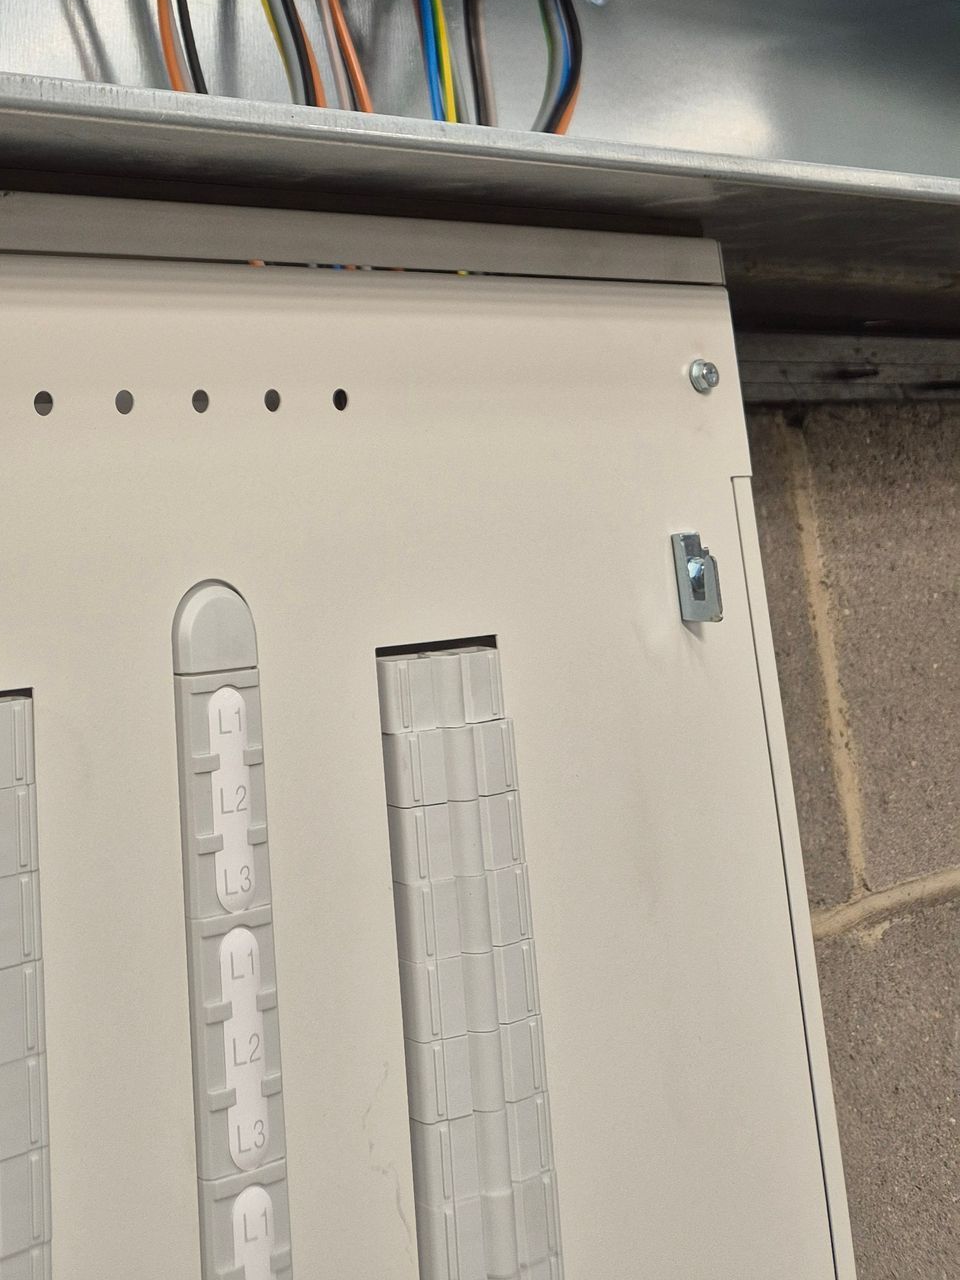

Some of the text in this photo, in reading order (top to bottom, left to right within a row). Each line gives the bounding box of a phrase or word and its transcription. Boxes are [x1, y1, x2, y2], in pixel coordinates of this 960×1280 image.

[218, 708, 242, 734] L1
[219, 785, 248, 815] L2
[223, 865, 252, 896] L3
[230, 949, 255, 980] L1
[232, 1032, 261, 1067] L2
[236, 1119, 266, 1154] L3
[244, 1208, 269, 1242] L1
